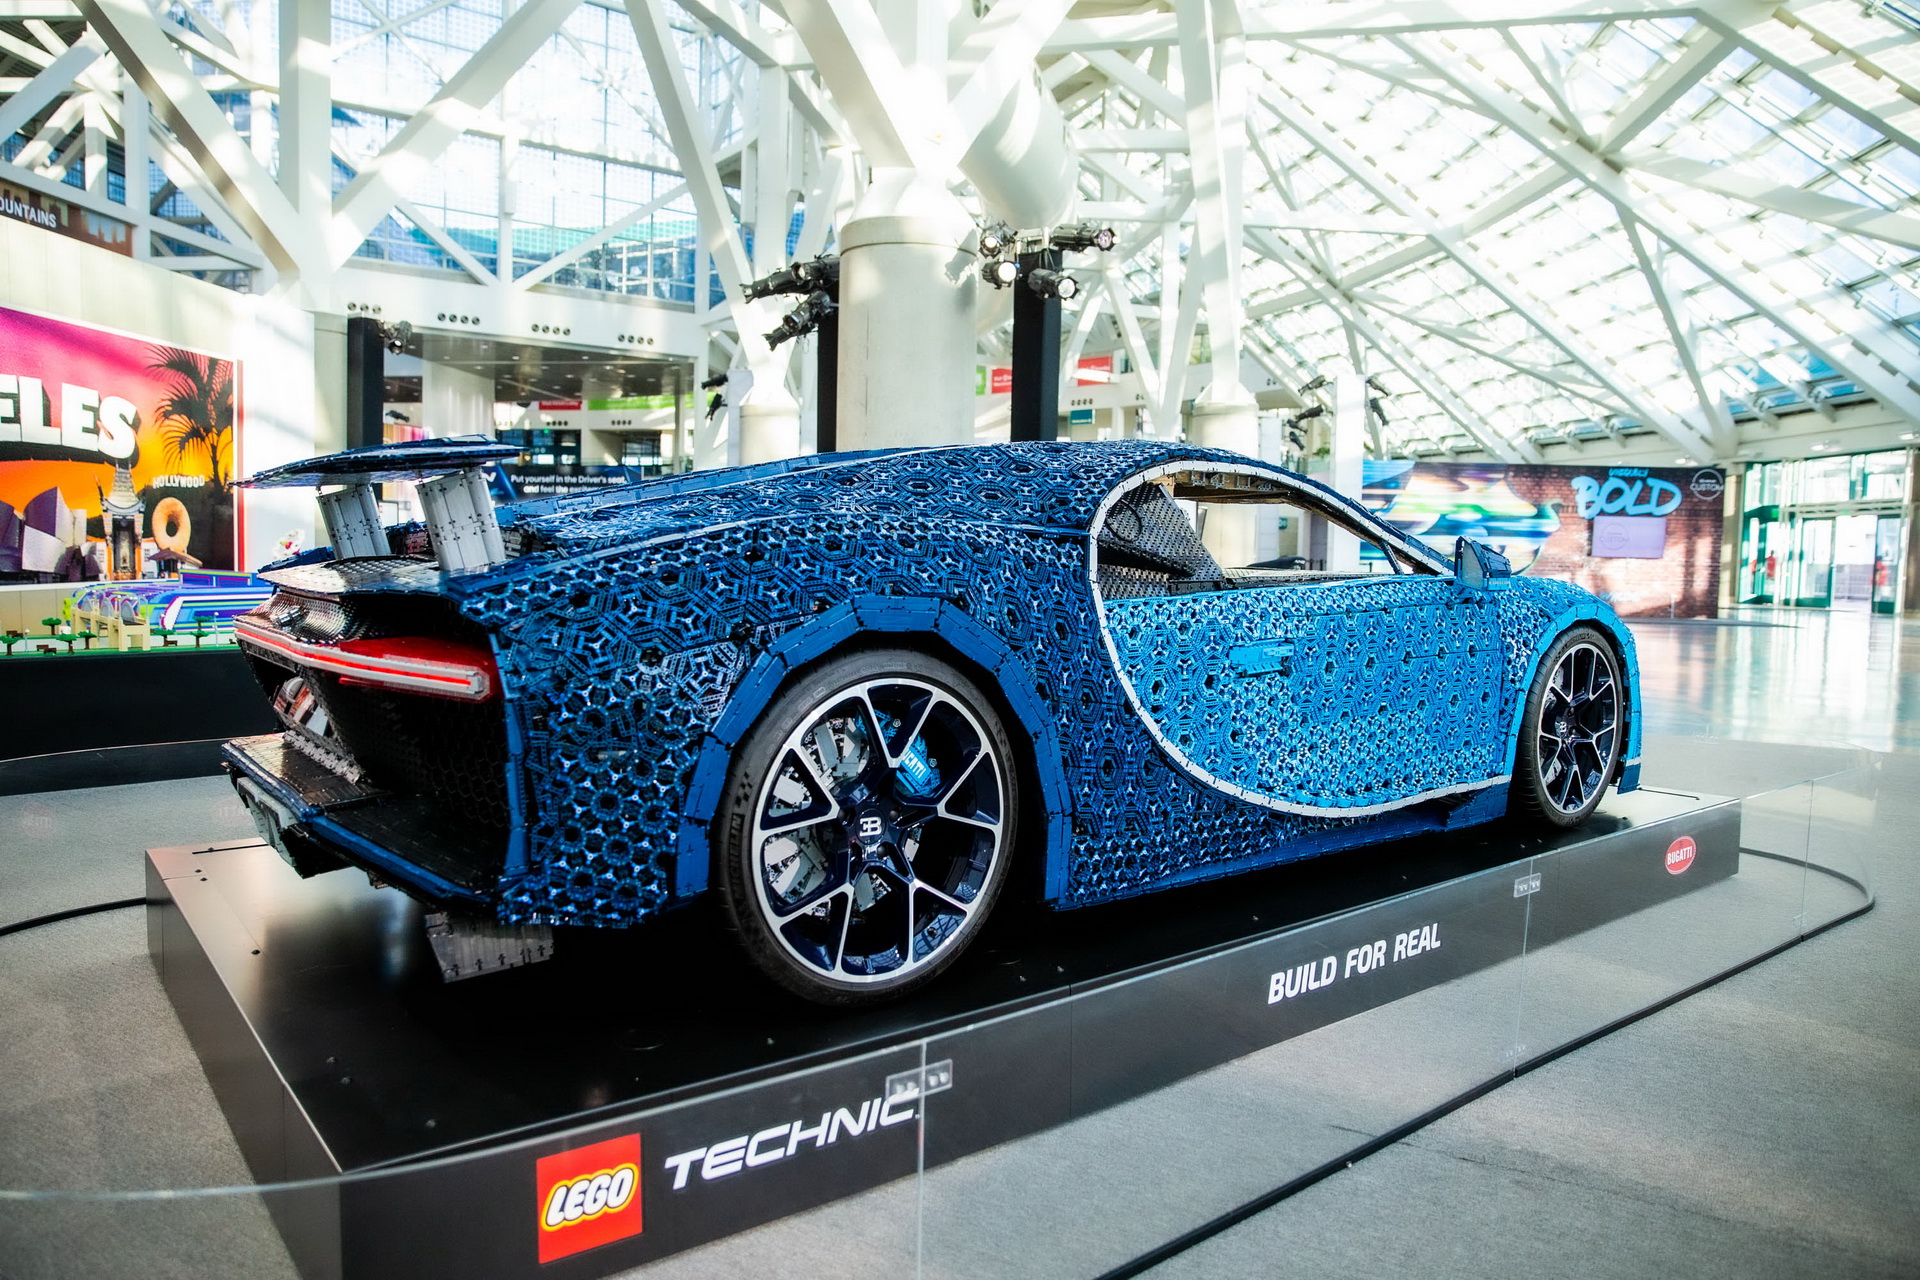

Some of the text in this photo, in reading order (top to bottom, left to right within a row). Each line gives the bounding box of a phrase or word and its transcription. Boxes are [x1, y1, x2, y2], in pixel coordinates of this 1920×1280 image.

[153, 474, 205, 489] HOLLYWOOD
[511, 474, 524, 483] Put
[525, 474, 555, 484] yourself
[556, 474, 563, 483] in
[564, 475, 577, 483] the
[578, 474, 607, 484] Driver's
[523, 484, 539, 493] and
[540, 485, 554, 493] feel
[556, 484, 569, 494] the
[1571, 475, 1682, 519] BOLD
[1667, 846, 1693, 866] BUGATTI
[1268, 923, 1441, 1004] BUILD FOR REAL
[545, 1087, 919, 1227] LEGO TECHNIC
